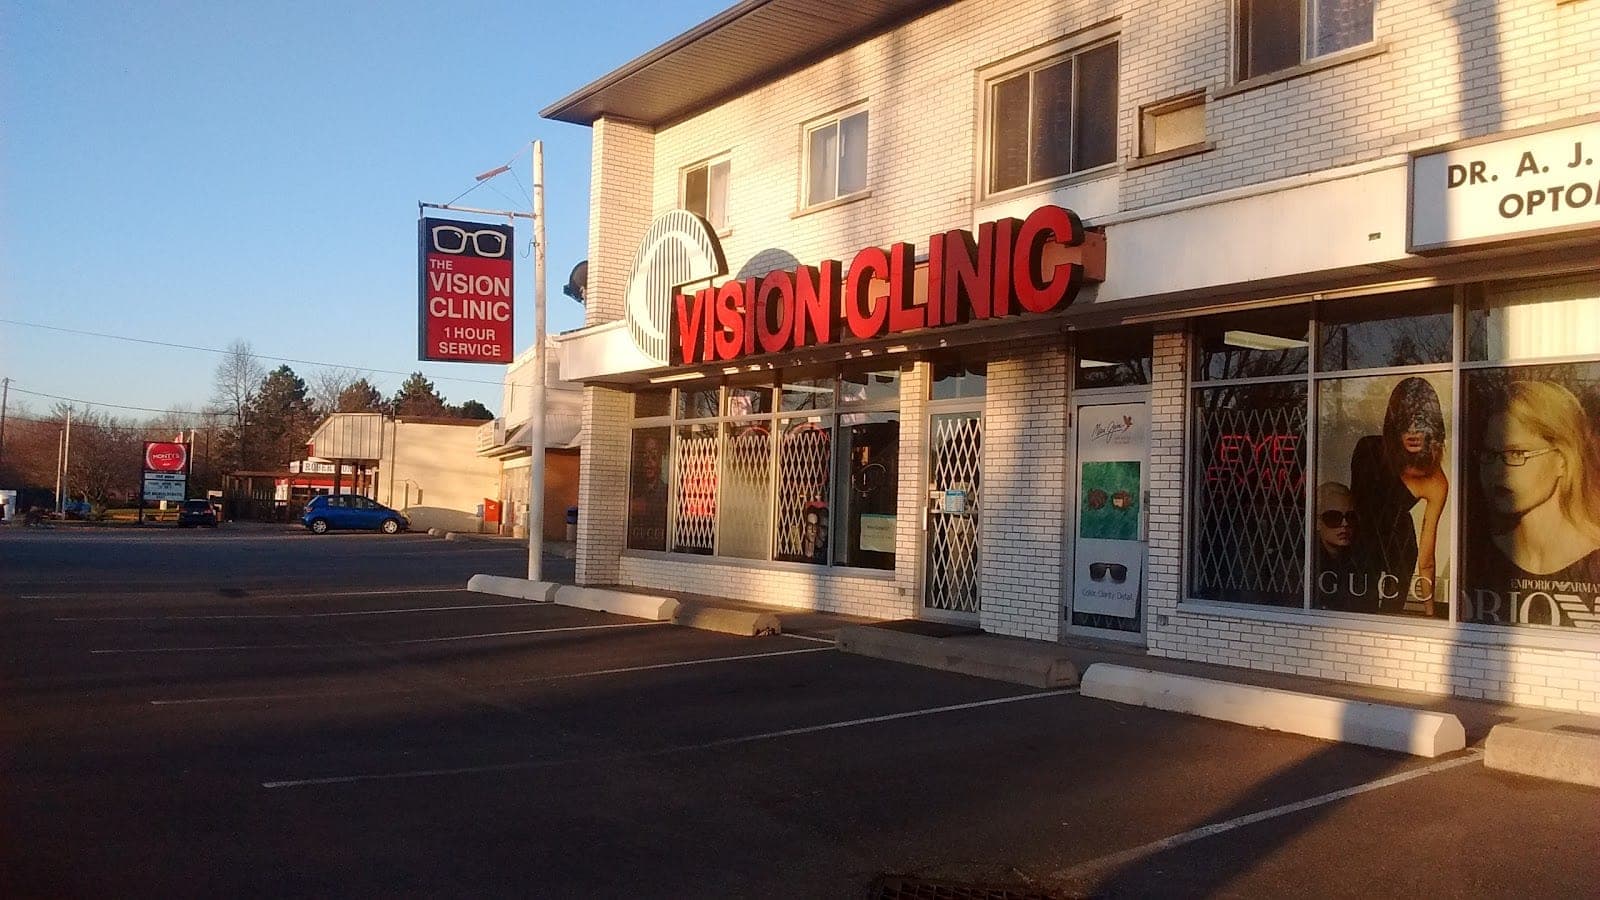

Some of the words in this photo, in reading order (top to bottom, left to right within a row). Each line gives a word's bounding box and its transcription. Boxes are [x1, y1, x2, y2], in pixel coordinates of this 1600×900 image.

[1447, 160, 1498, 189] DR.
[1515, 151, 1549, 177] A.
[1567, 142, 1593, 168] J.
[1499, 182, 1600, 218] OPTO
[430, 258, 453, 270] THE
[430, 271, 510, 297] VISION
[675, 259, 836, 365] VISION
[846, 203, 1078, 339] CLINIC
[429, 296, 510, 321] CLINIC
[444, 327, 450, 338] 1
[454, 327, 496, 340] HOUR
[439, 341, 501, 356] SERVICE
[1221, 434, 1298, 464] EYE
[1510, 578, 1556, 591] EMPORIO
